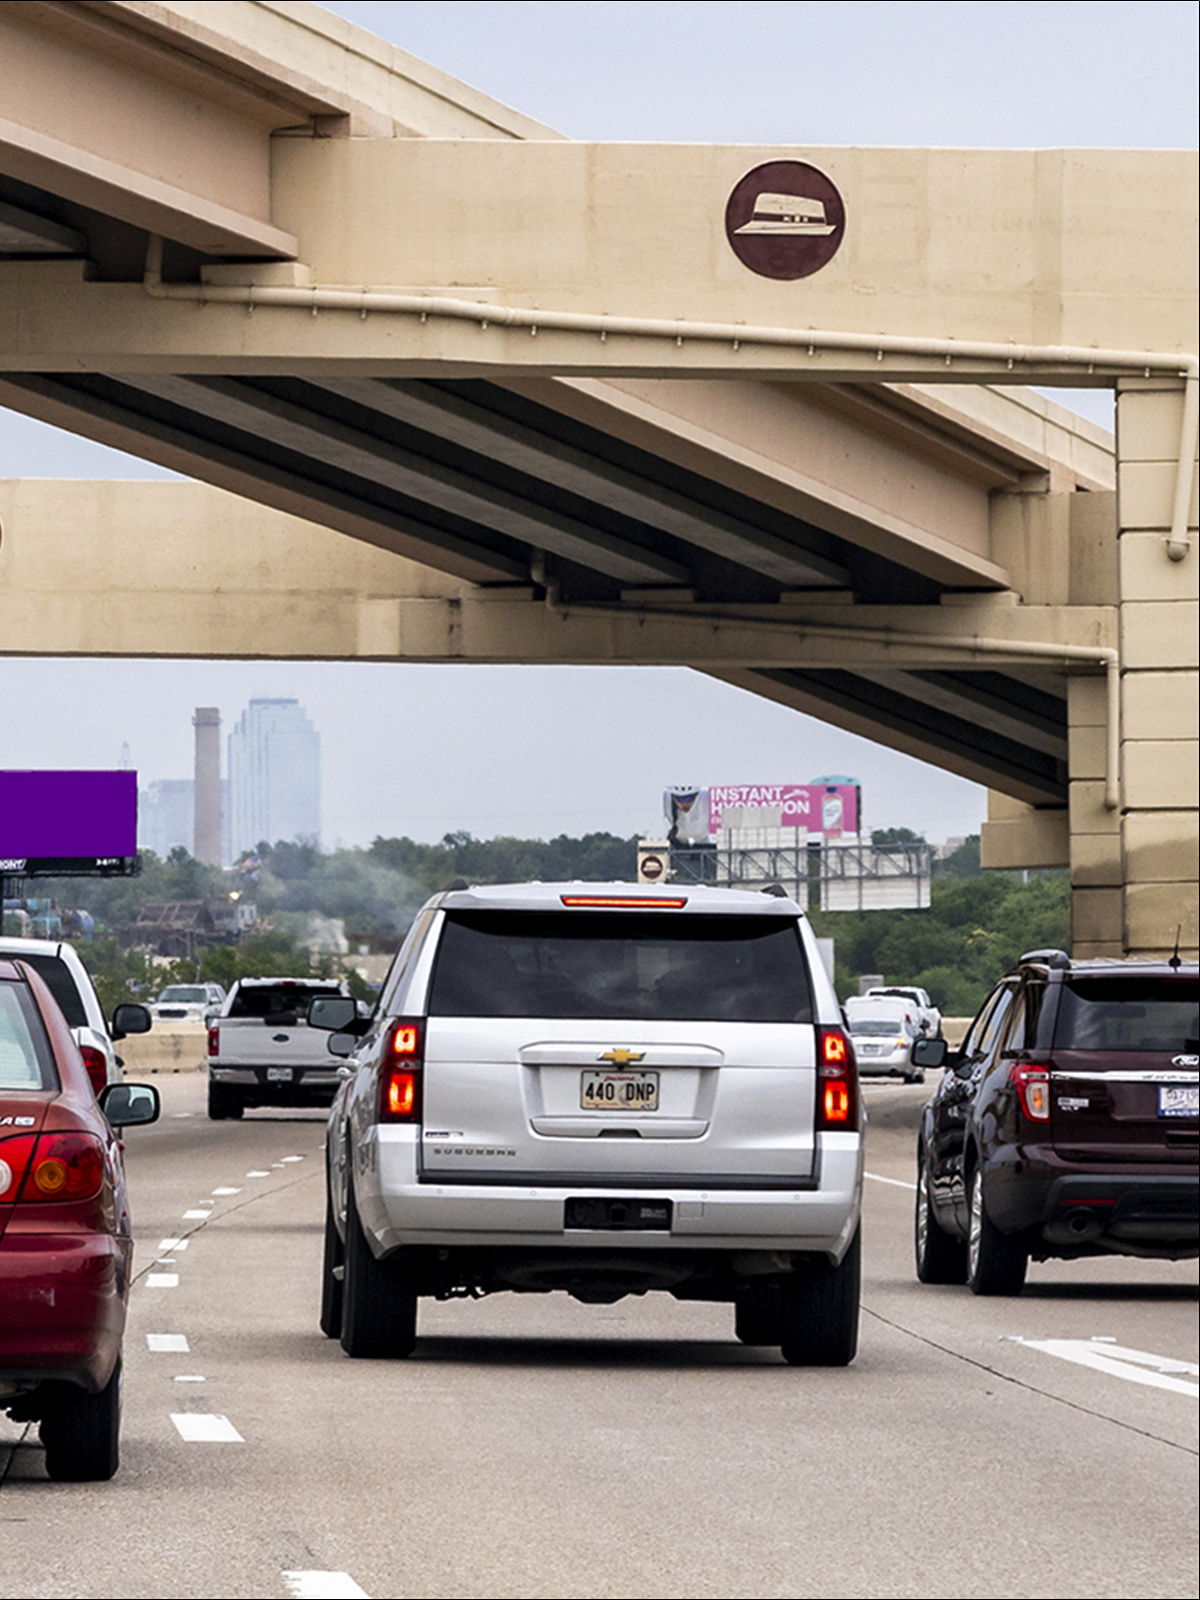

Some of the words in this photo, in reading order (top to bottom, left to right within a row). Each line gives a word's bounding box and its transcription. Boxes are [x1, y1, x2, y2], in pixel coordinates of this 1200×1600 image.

[710, 787, 784, 801] INSTANT
[585, 1082, 615, 1101] 440
[626, 1082, 655, 1101] DNP
